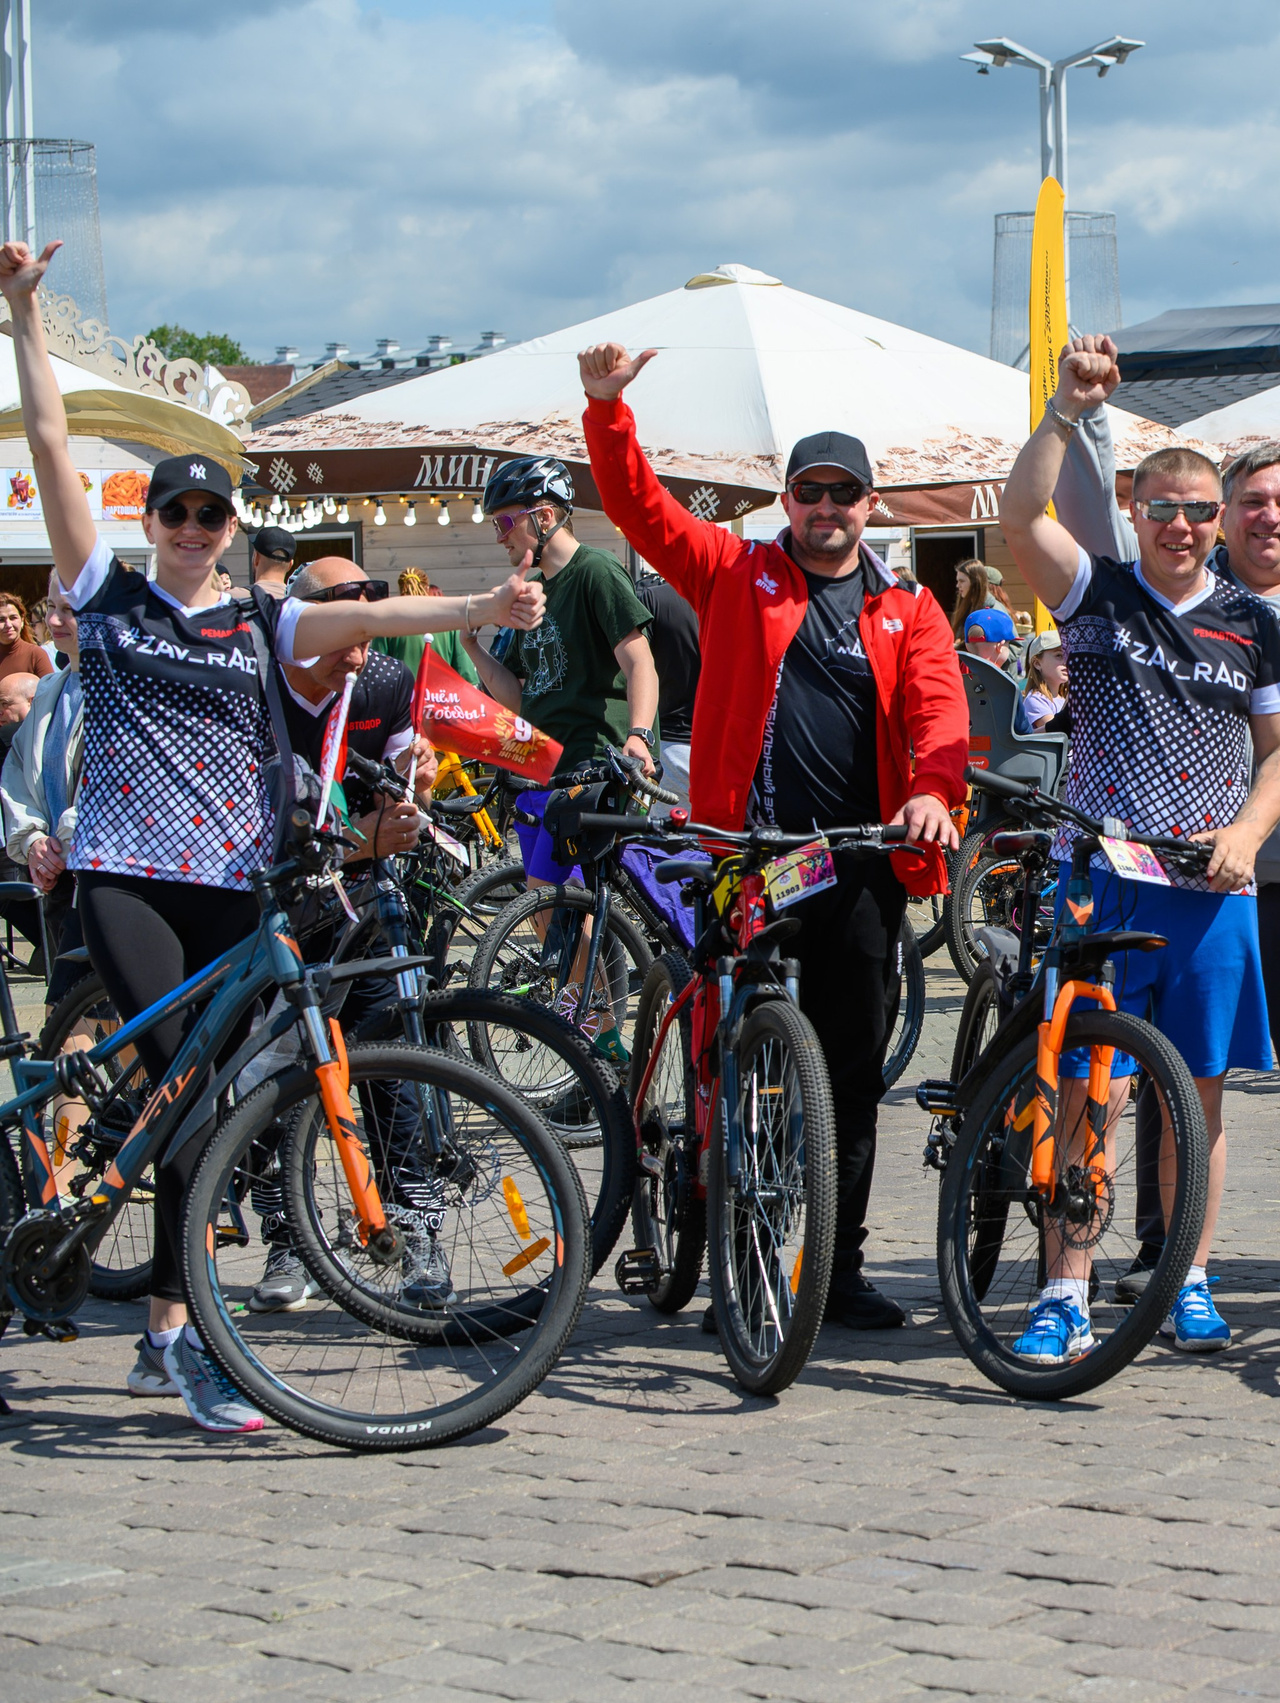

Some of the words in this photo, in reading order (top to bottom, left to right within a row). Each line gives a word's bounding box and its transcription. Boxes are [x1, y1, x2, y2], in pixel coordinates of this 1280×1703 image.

[413, 454, 500, 488] МИН
[514, 716, 533, 742] 9
[775, 884, 800, 900] 11903
[365, 1420, 432, 1435] KENDA
